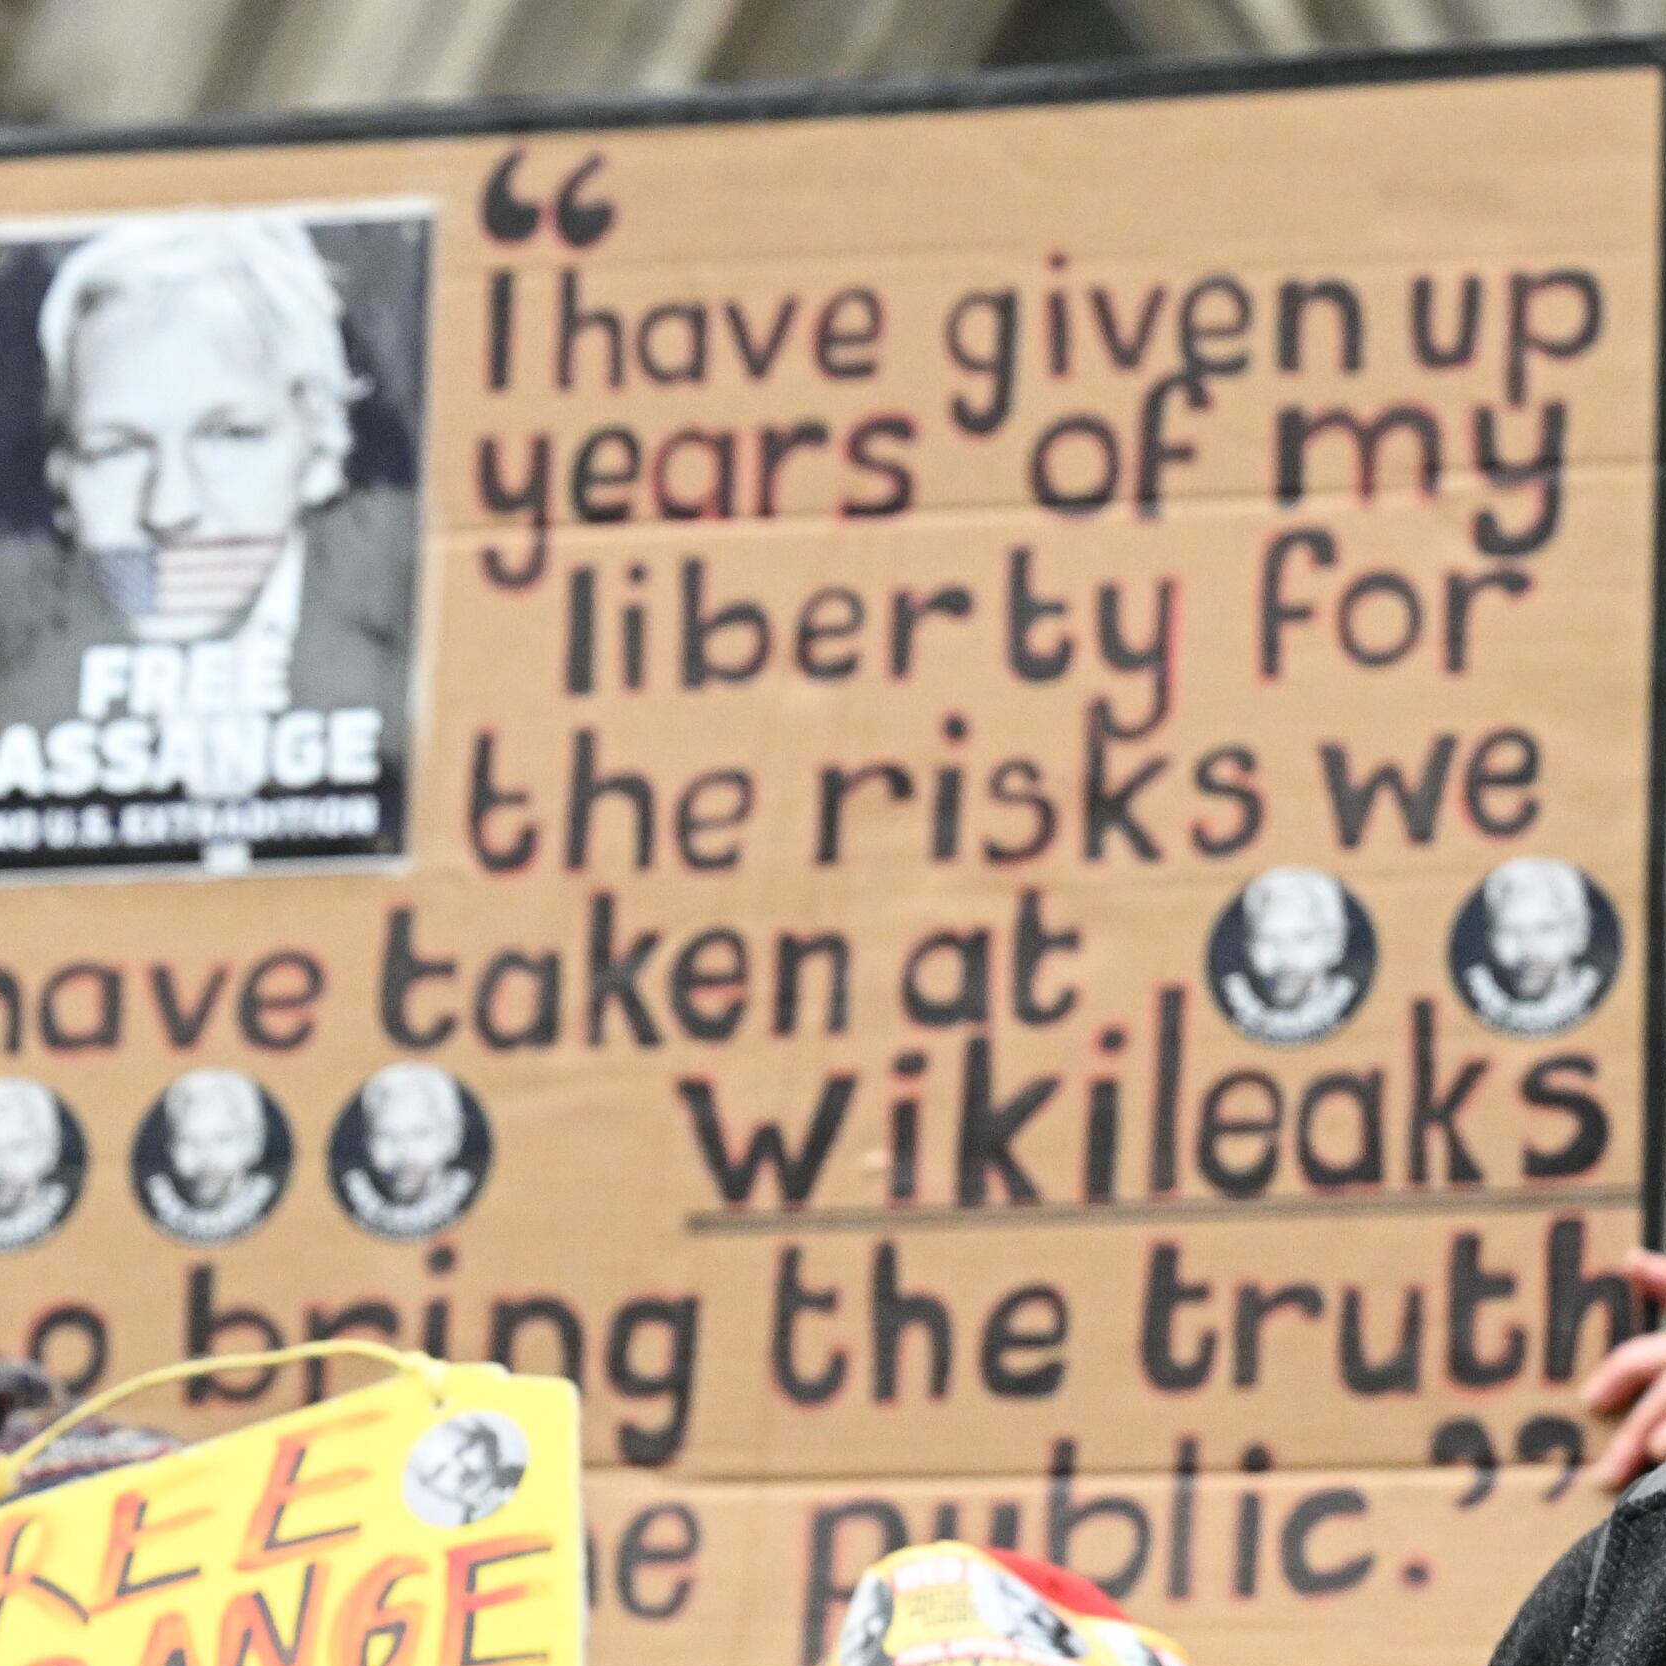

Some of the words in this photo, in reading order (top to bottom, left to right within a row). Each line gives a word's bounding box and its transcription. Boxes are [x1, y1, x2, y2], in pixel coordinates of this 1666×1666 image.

[554, 265, 885, 394] have
[944, 250, 1364, 438] given
[1408, 267, 1605, 407] up
[476, 410, 919, 590] years
[1027, 368, 1211, 522] of
[1275, 400, 1569, 559] my
[80, 643, 291, 719] FREE
[564, 545, 1179, 741] liberty
[1257, 527, 1535, 684] for
[466, 725, 755, 876] the
[813, 697, 1267, 866] risks
[1314, 727, 1545, 852] we
[378, 891, 855, 1052] taken
[900, 886, 1081, 1032] at
[673, 985, 1614, 1210] wikileaks
[184, 1243, 703, 1468] bring
[769, 1239, 1074, 1408] the
[1139, 1217, 1636, 1396] truth
